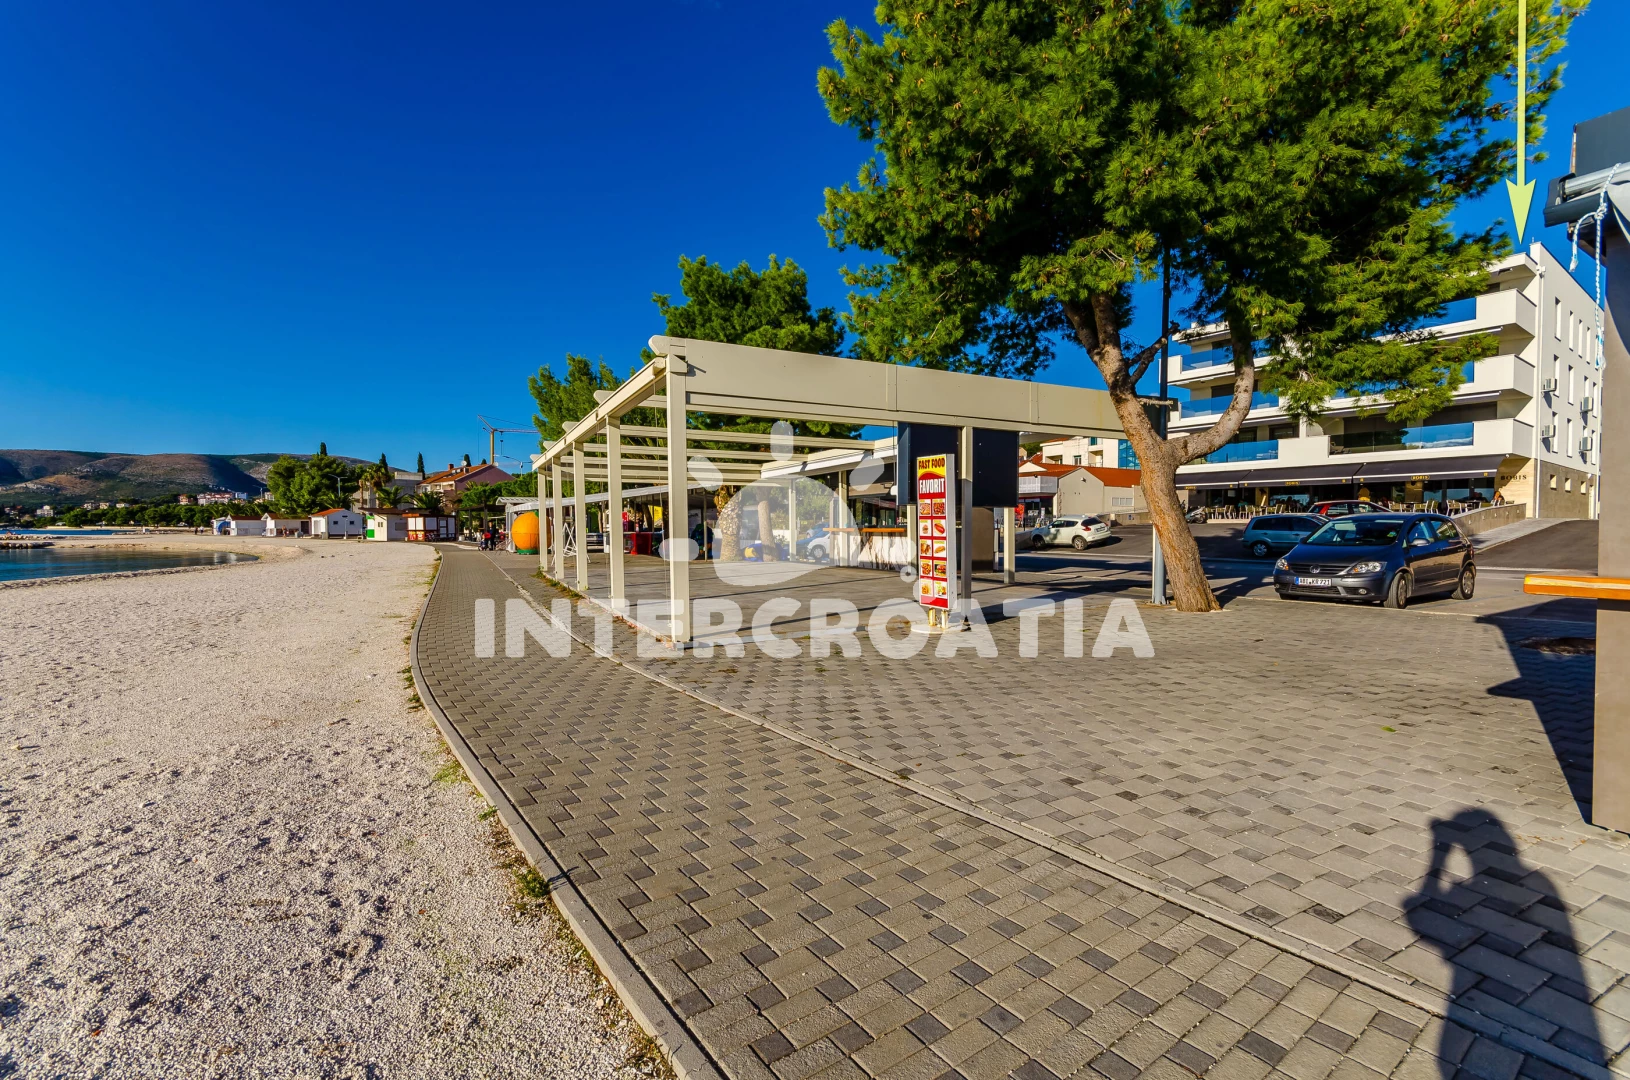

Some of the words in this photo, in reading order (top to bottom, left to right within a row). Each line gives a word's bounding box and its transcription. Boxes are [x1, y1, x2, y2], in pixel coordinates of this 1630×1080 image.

[918, 459, 930, 470] FAST
[931, 457, 945, 469] FOOD
[919, 478, 945, 494] FAVORIT
